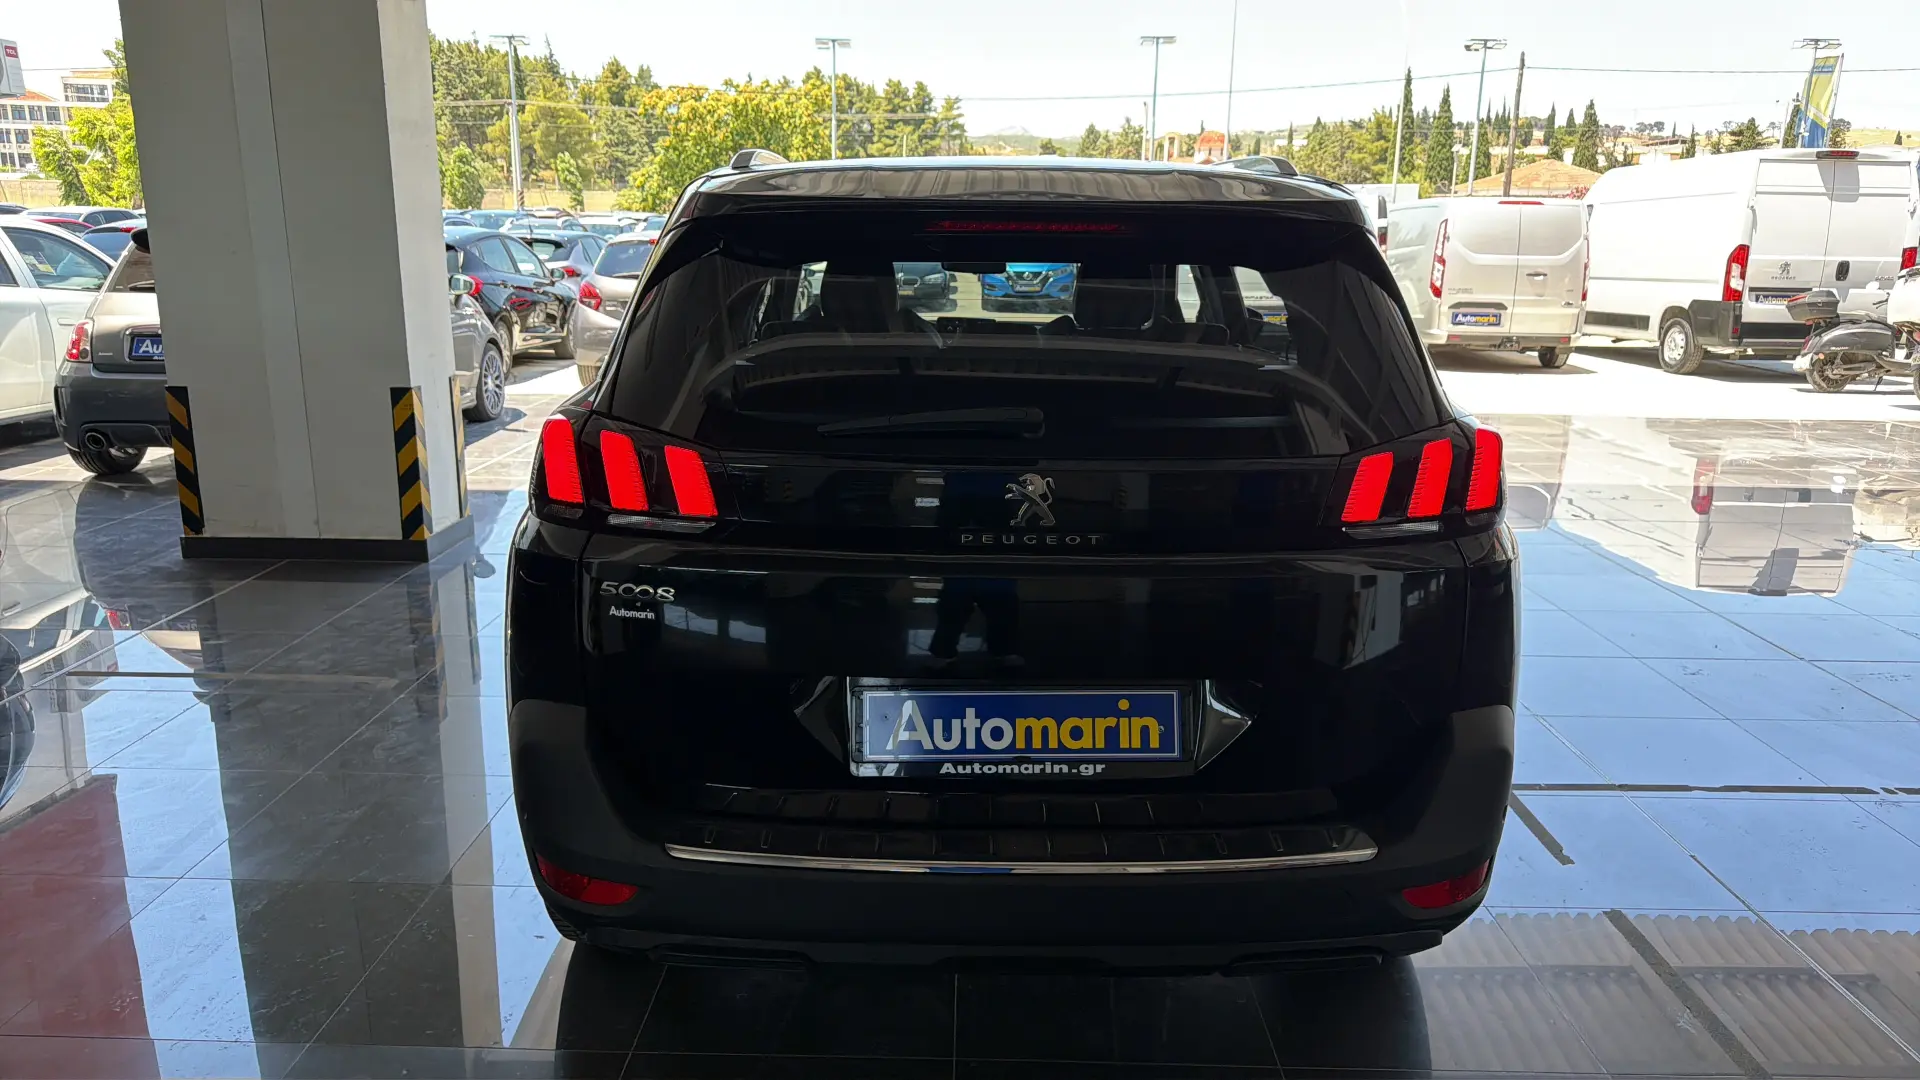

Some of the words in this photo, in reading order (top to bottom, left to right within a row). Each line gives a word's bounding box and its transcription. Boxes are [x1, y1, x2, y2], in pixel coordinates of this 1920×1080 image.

[1455, 313, 1497, 323] Automarin
[138, 339, 164, 354] Au
[961, 534, 1101, 545] PEUGEOT
[599, 581, 676, 602] 5008
[609, 605, 656, 620] Automarin
[885, 698, 1161, 751] Automarin
[939, 761, 1106, 776] Automarin.gr
